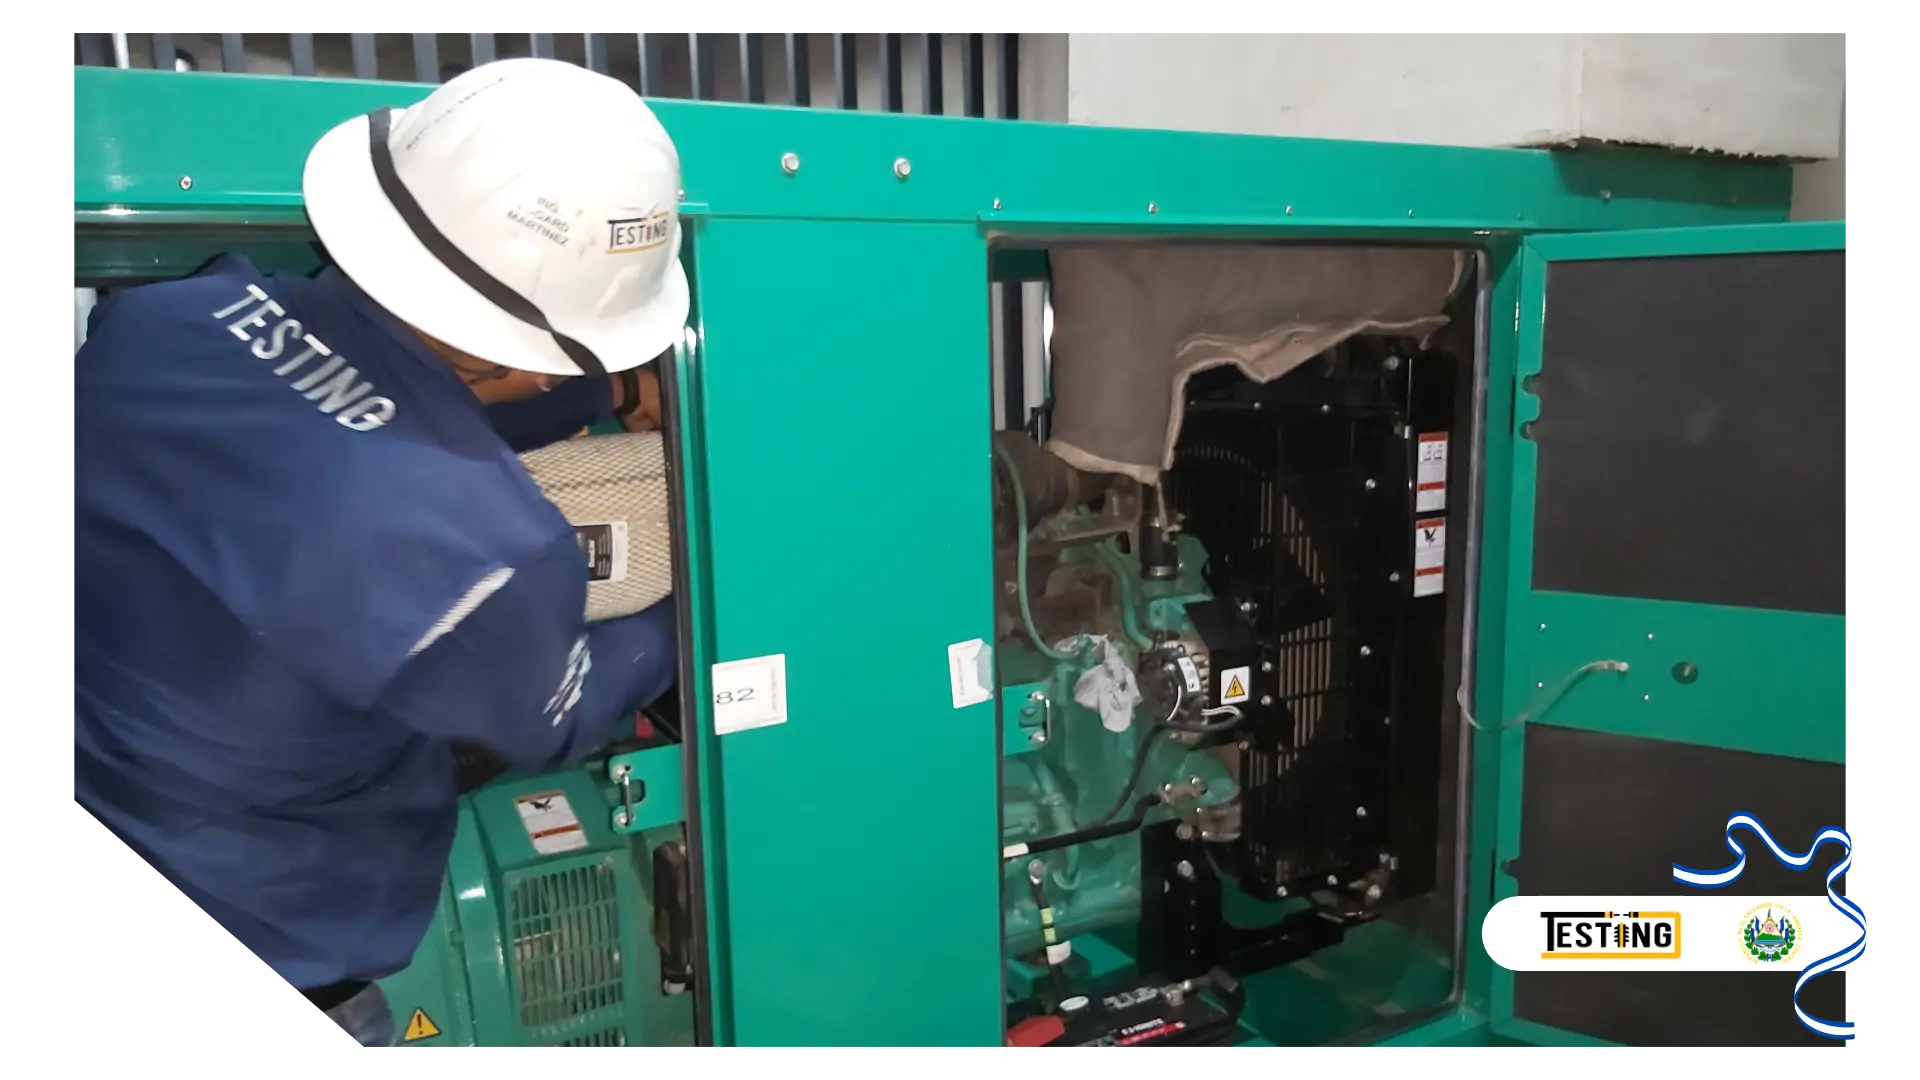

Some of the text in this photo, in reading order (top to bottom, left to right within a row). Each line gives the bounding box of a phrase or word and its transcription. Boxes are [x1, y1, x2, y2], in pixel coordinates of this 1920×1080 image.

[507, 209, 571, 249] MARTINEZ
[607, 214, 669, 249] TESTING
[211, 283, 396, 432] TESTING
[715, 687, 755, 706] 82
